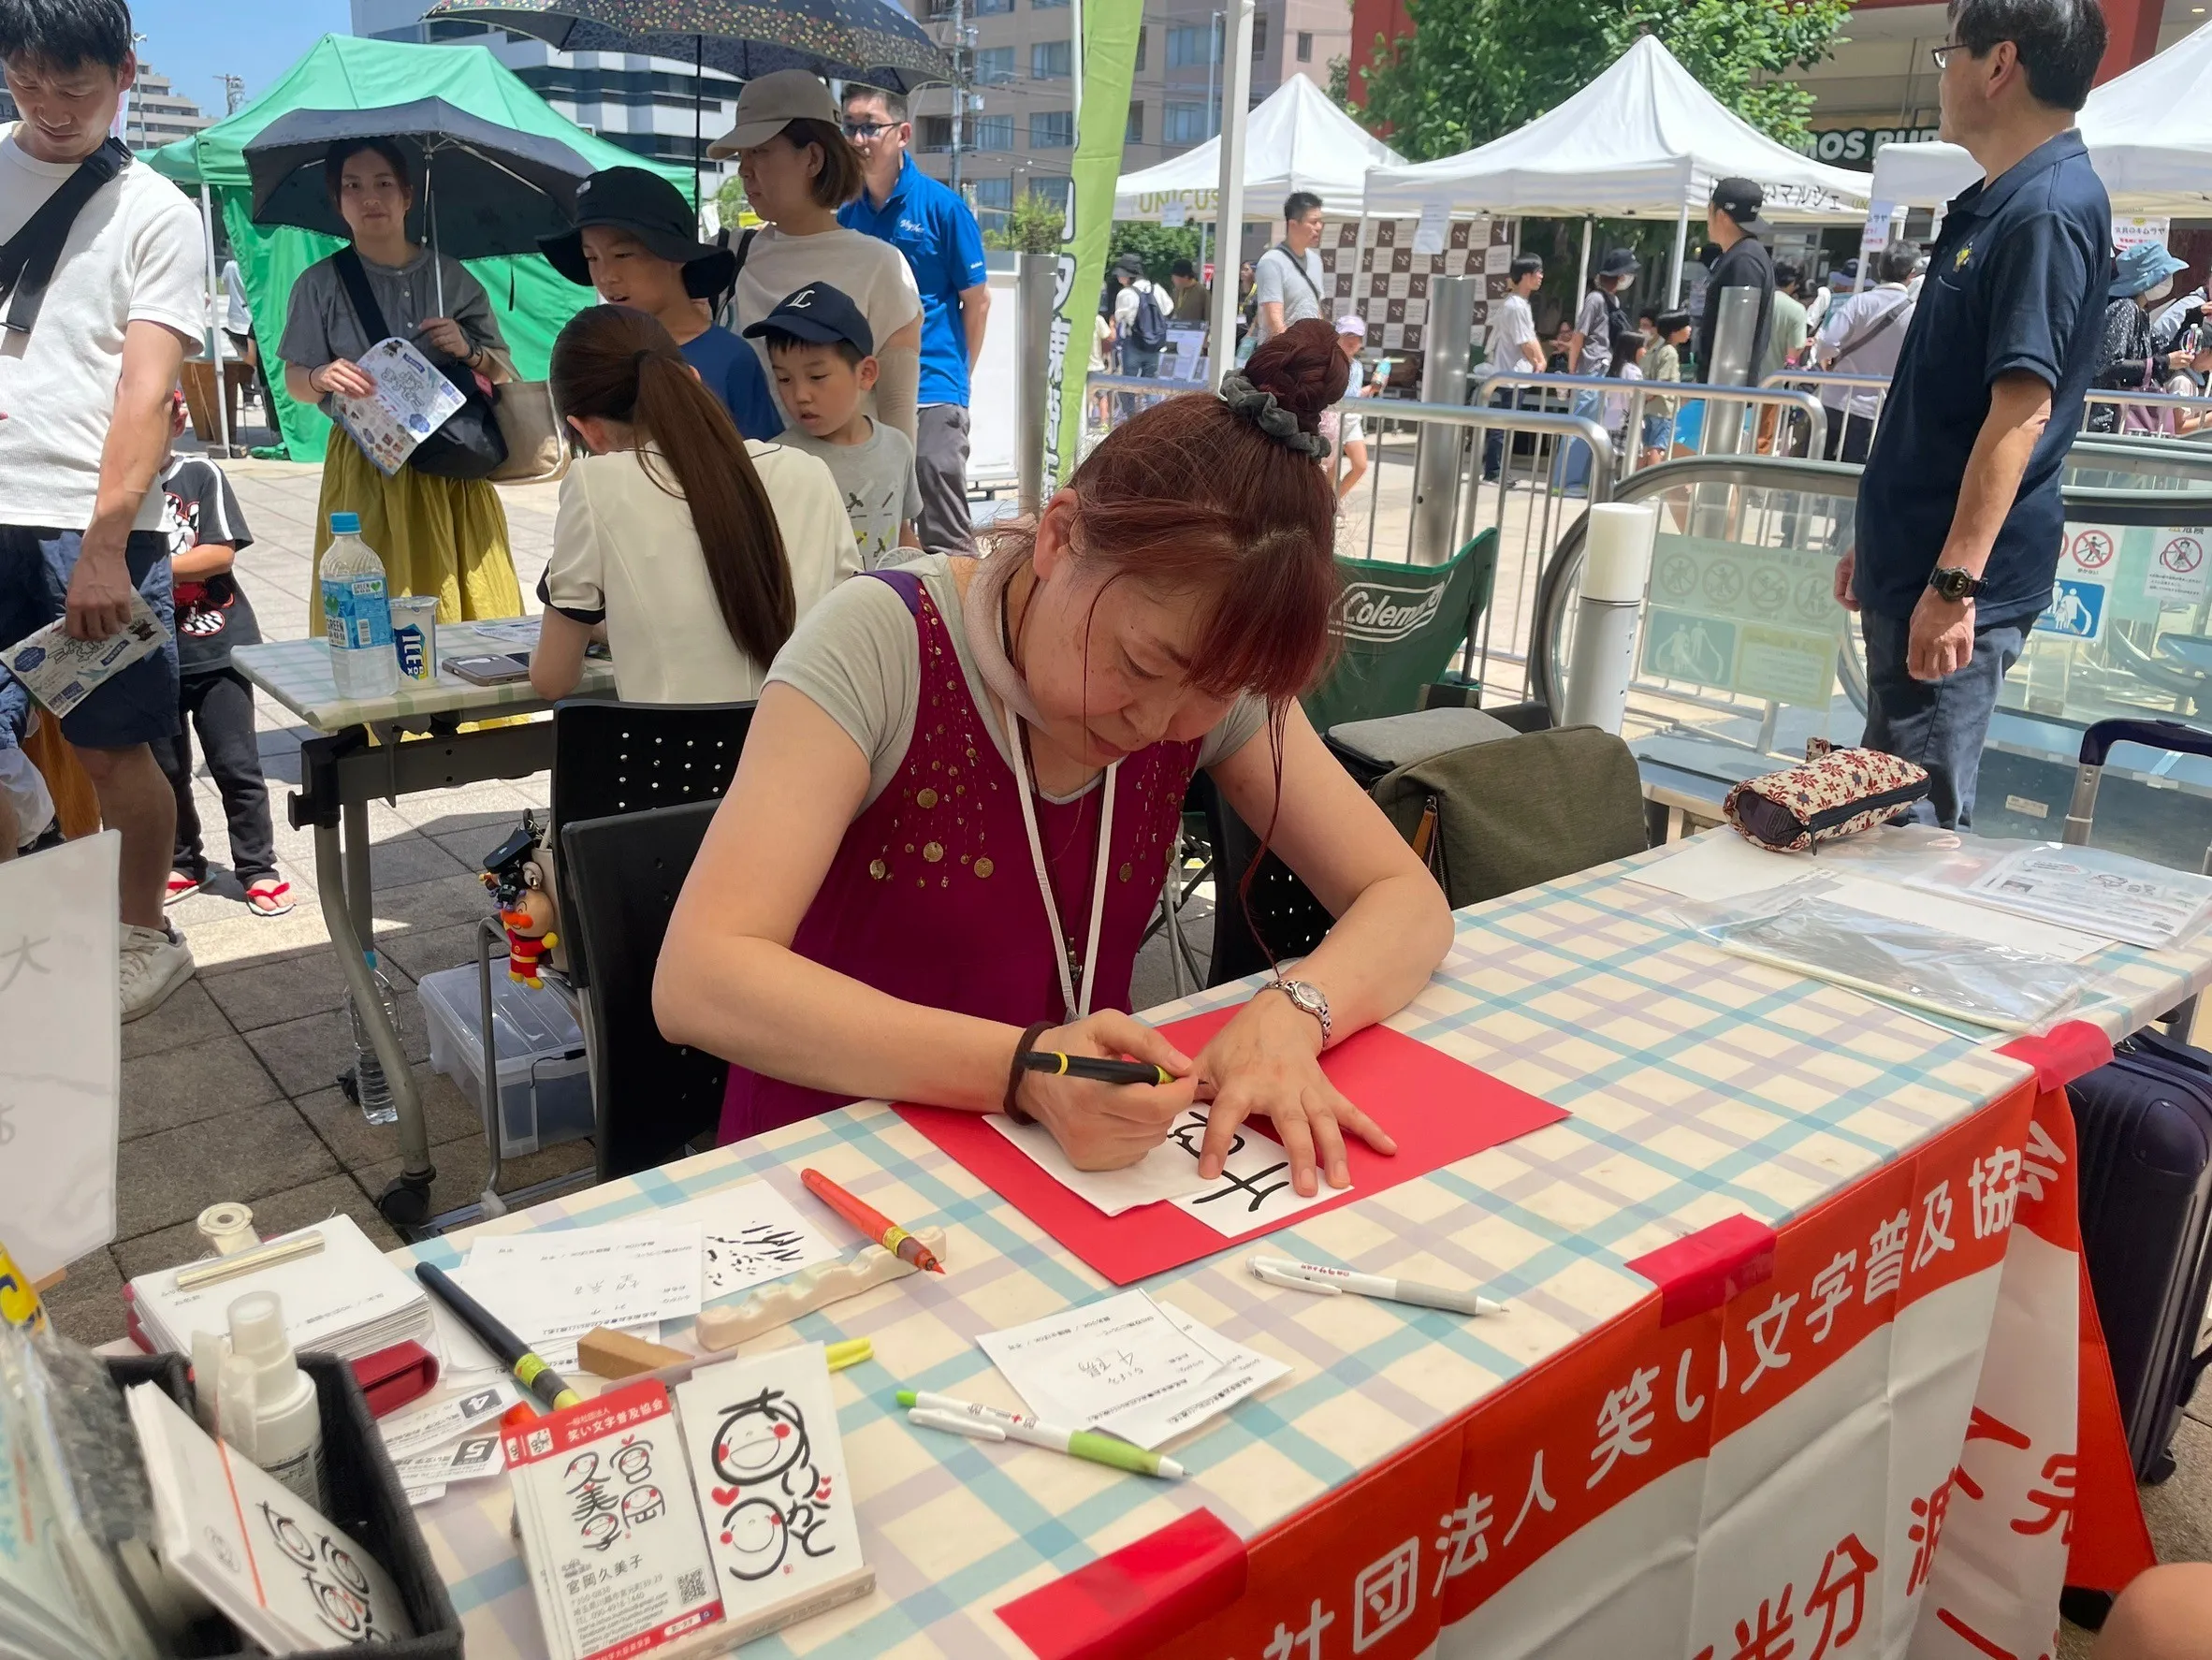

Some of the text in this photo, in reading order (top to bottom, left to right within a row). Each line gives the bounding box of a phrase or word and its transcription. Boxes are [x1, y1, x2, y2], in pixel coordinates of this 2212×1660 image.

[402, 634, 423, 664] ICE
[467, 1394, 490, 1411] 4
[567, 1397, 664, 1442] 笑い文字普及協会
[463, 1439, 489, 1459] 5
